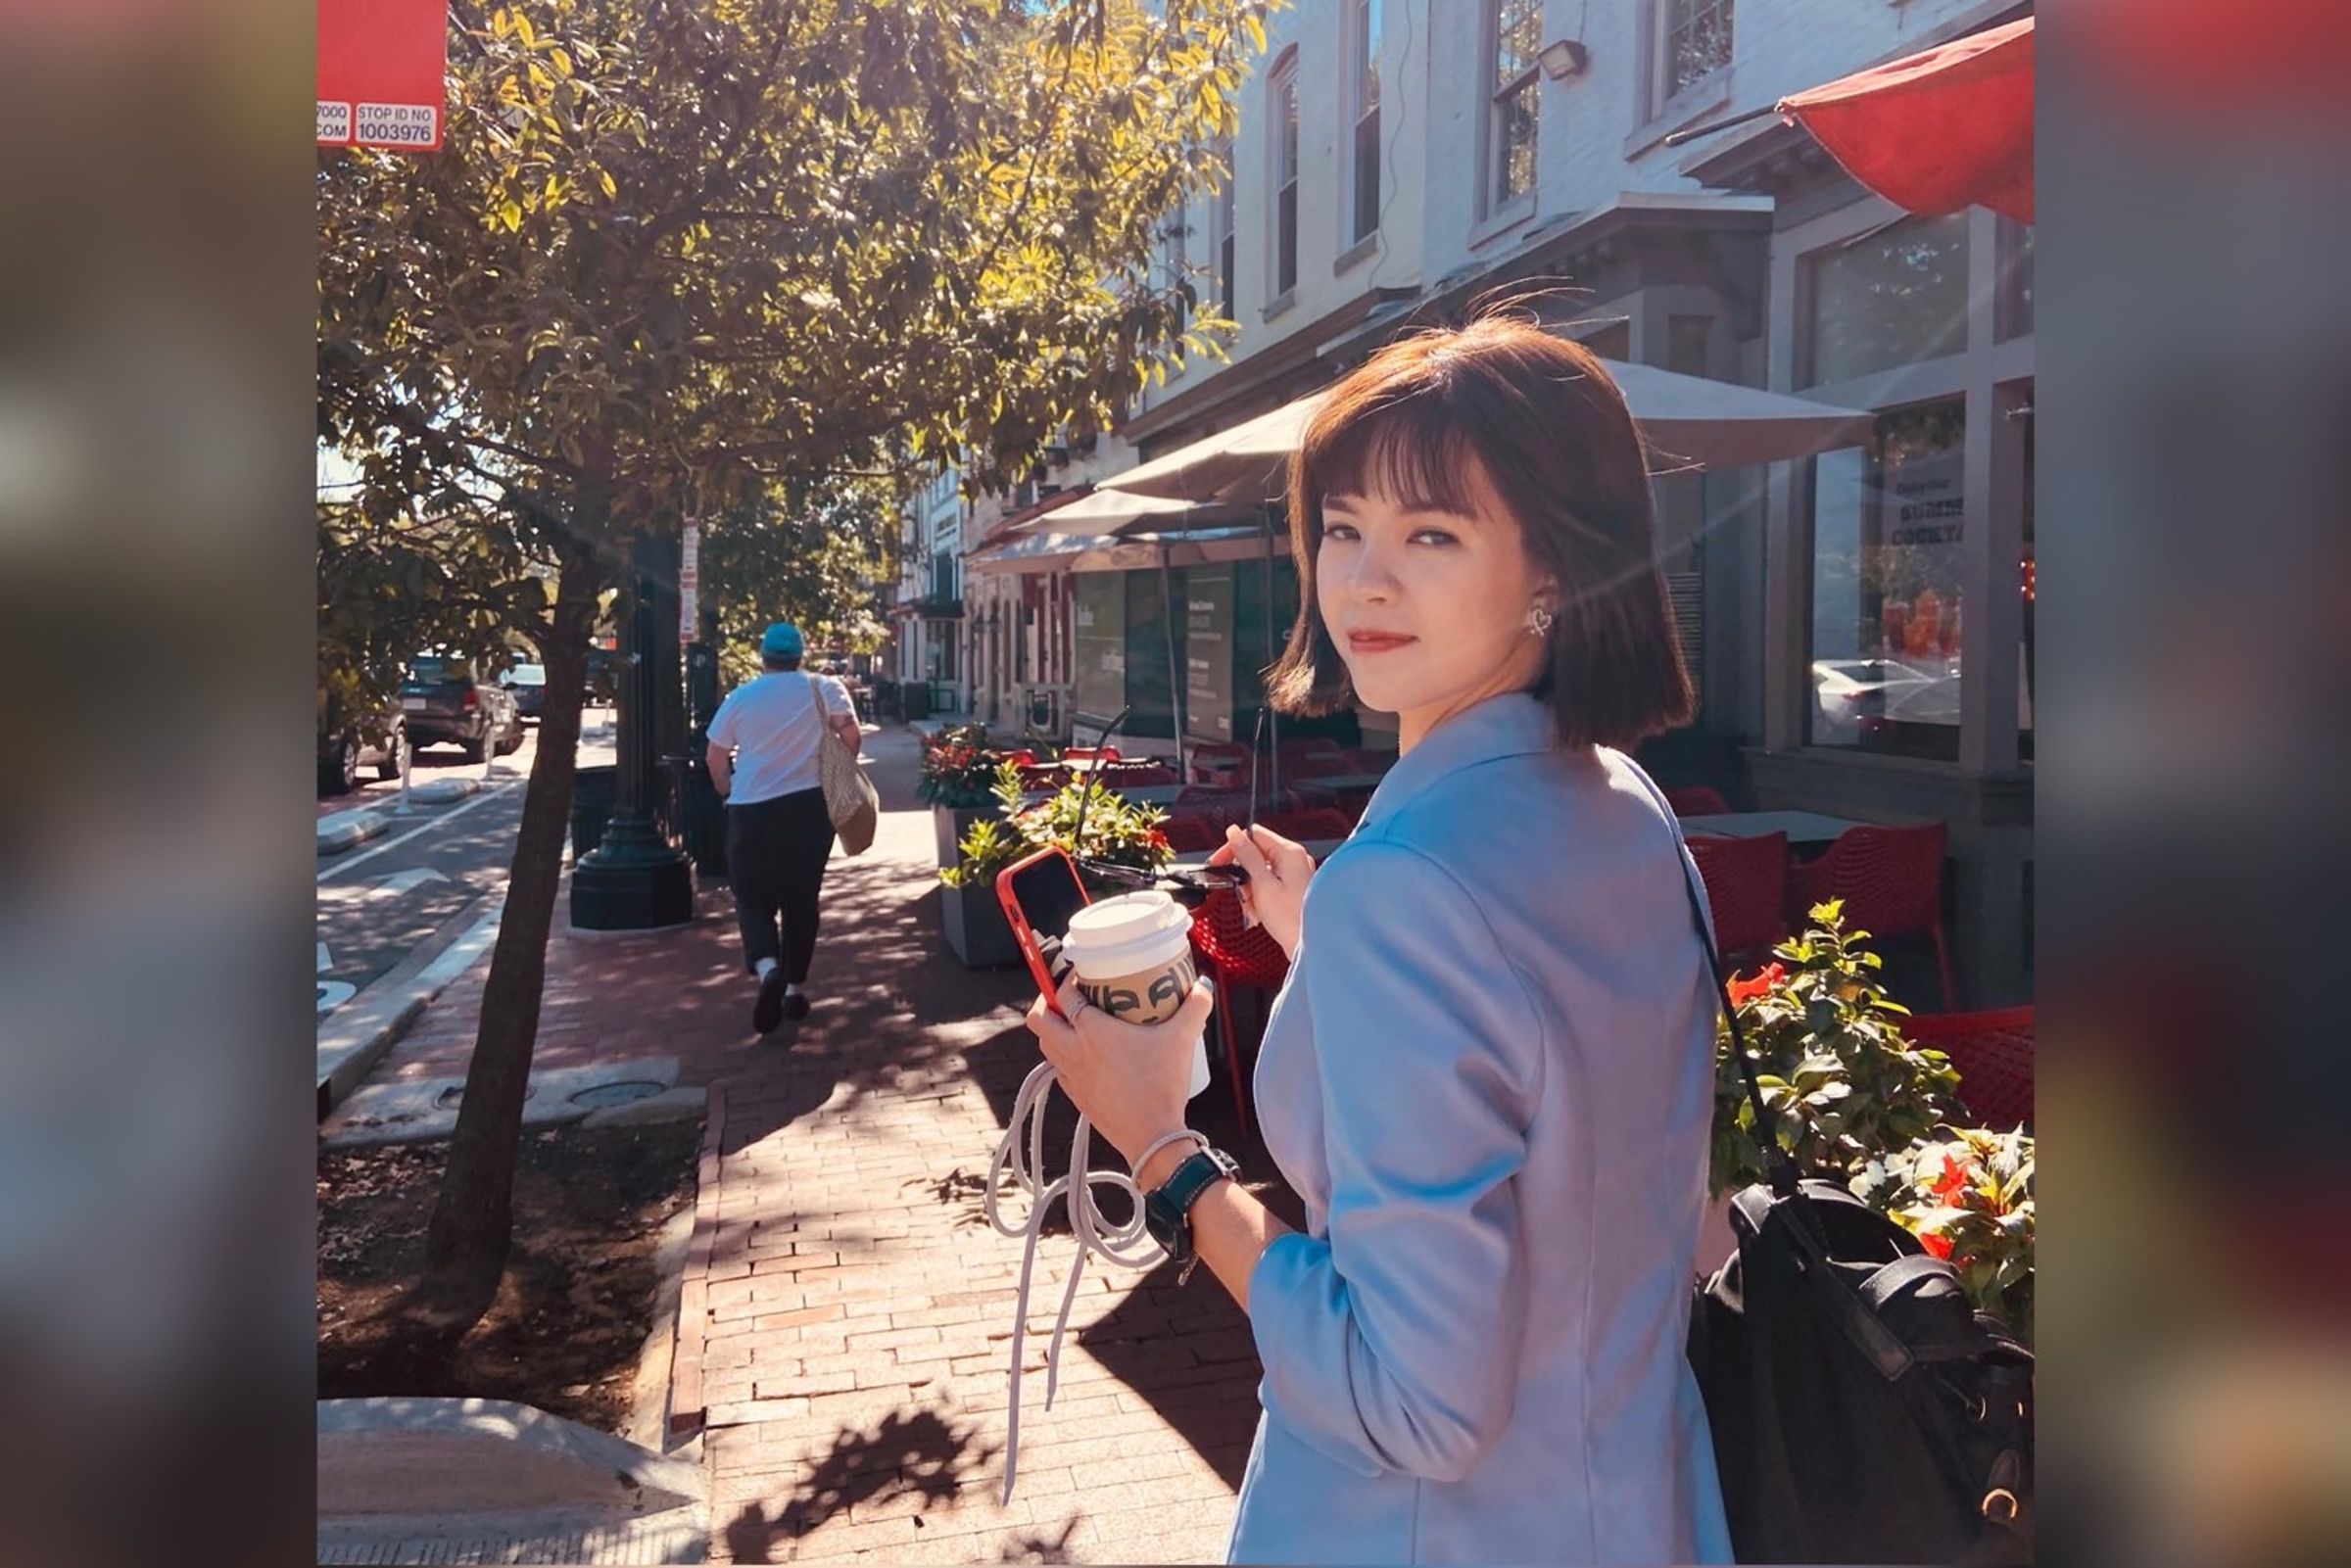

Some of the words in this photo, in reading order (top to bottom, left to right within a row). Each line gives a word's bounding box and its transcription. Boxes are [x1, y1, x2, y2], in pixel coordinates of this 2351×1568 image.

[359, 106, 392, 119] STOP
[395, 108, 408, 120] ID
[411, 109, 431, 121] NO
[359, 123, 431, 141] 1003976
